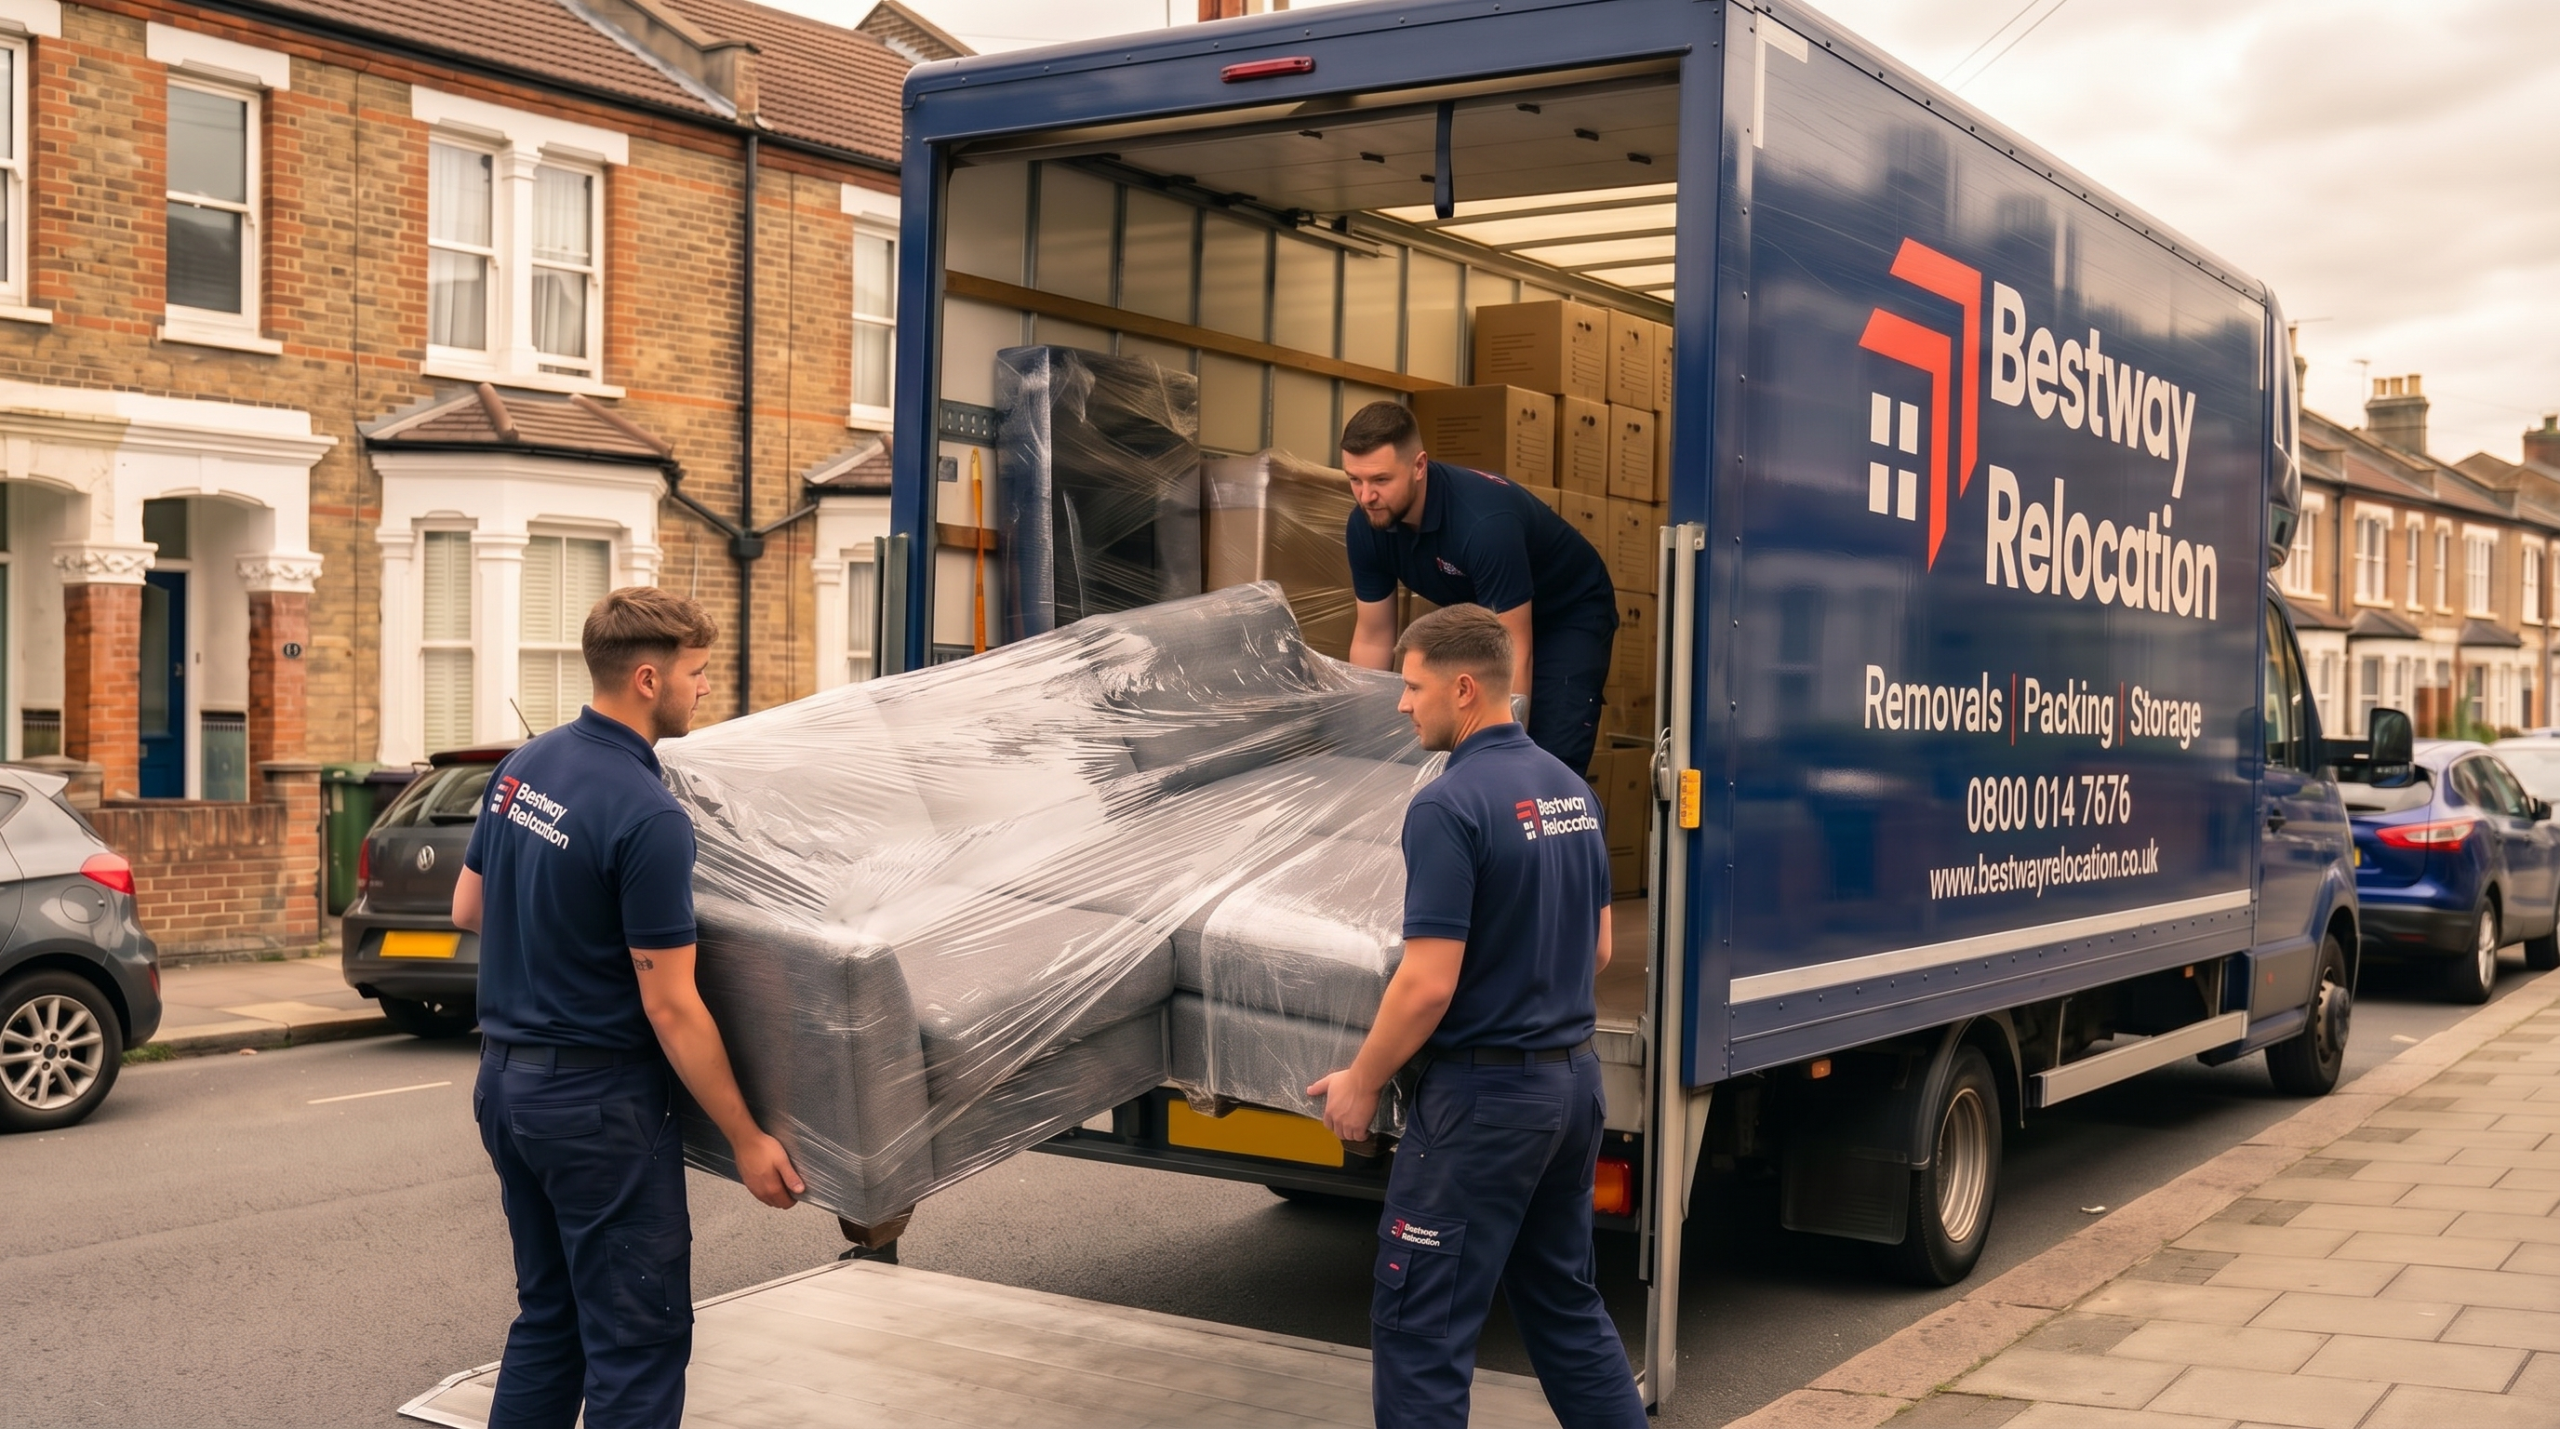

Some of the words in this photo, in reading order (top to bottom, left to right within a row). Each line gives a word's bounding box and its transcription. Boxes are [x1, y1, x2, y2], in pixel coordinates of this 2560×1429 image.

[1991, 281, 2196, 499] Bestway
[1986, 464, 2217, 620] Relocation
[1864, 664, 2003, 733] Removals
[2024, 677, 2114, 749] Packing
[2130, 685, 2201, 750] Storage
[516, 782, 568, 827] Bestway
[1967, 776, 2028, 833] 0800
[2034, 775, 2075, 829] 014
[2081, 774, 2131, 826] 7676
[1930, 837, 2159, 900] www.bestwayrelocation.co.uk
